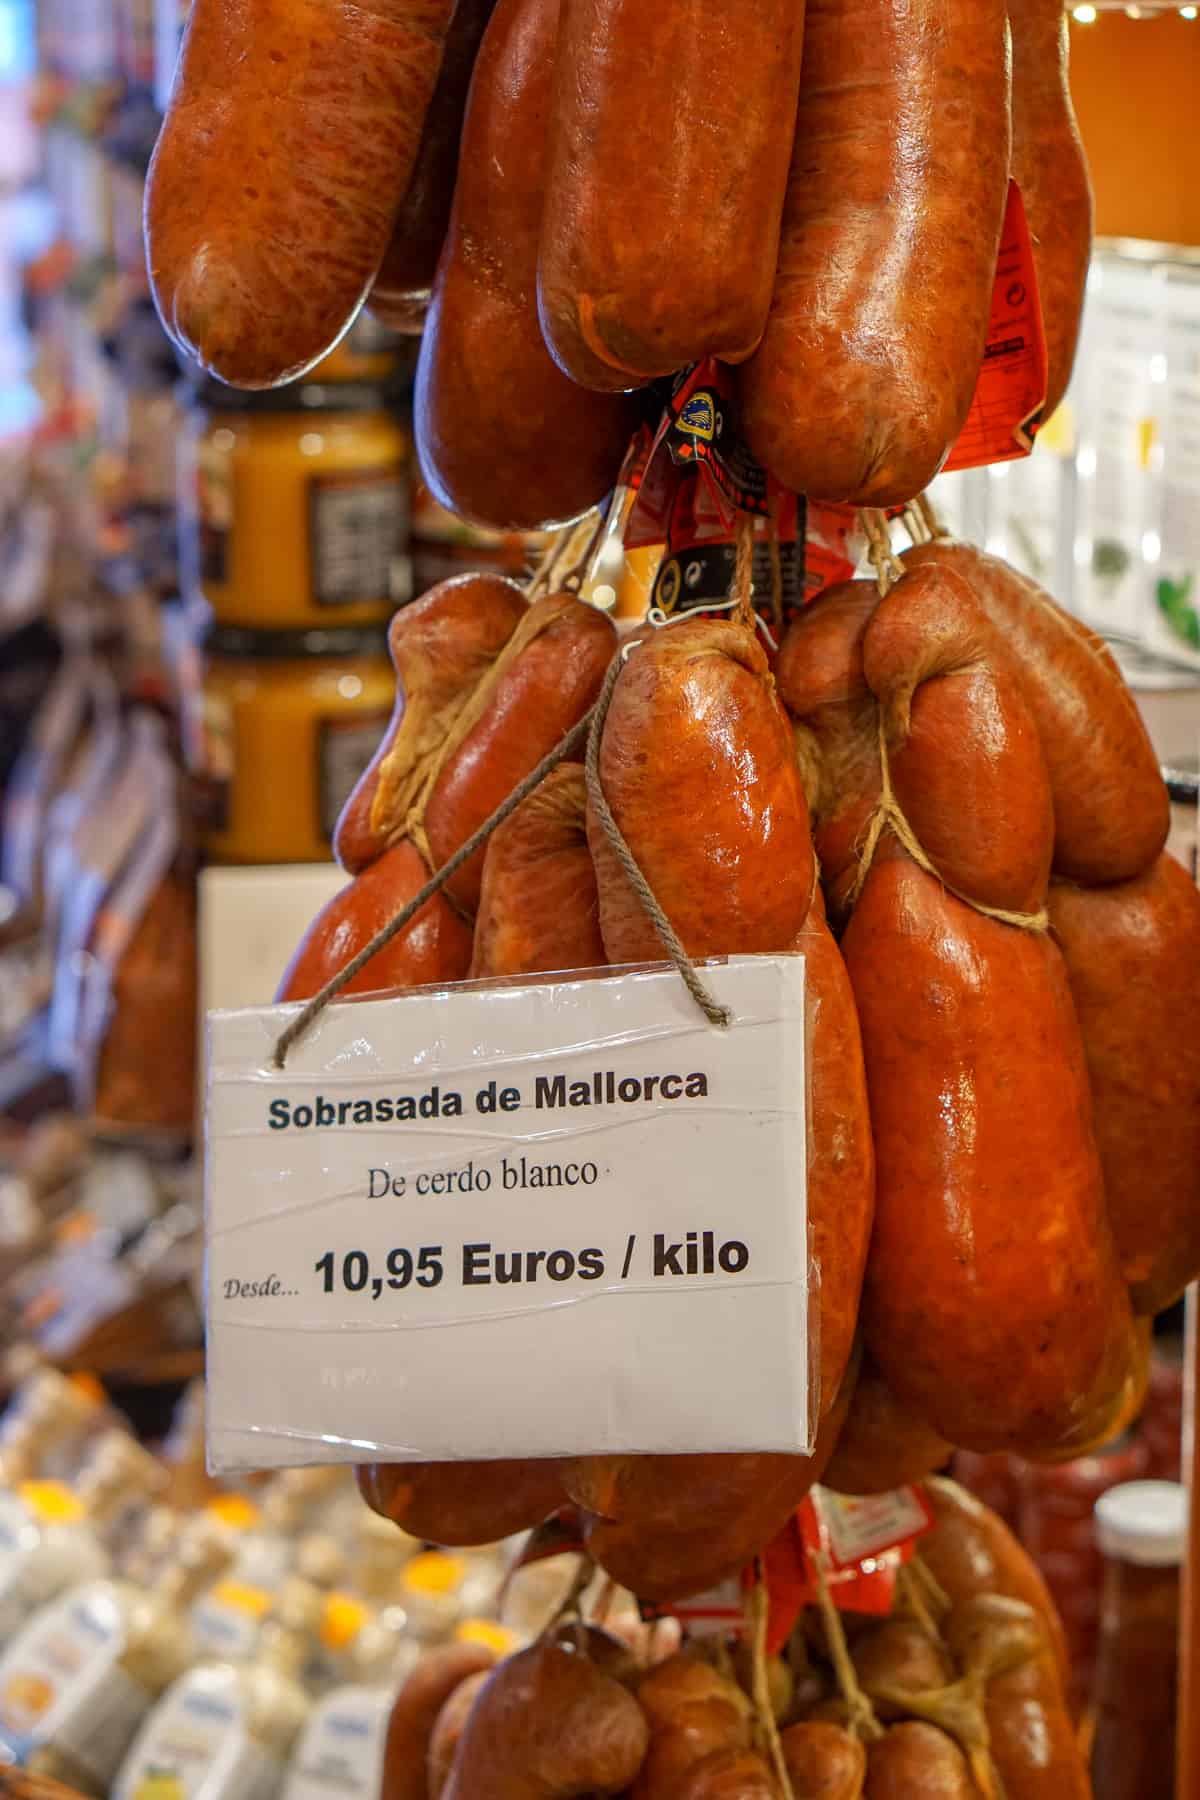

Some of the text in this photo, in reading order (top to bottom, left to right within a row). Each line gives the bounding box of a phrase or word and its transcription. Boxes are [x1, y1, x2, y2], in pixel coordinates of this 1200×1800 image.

[268, 1072, 708, 1130] Sobrasada de Mallorca
[368, 1157, 598, 1198] De cerdo blanco
[224, 1231, 749, 1301] Desde... 10,95 Euros / kilo
